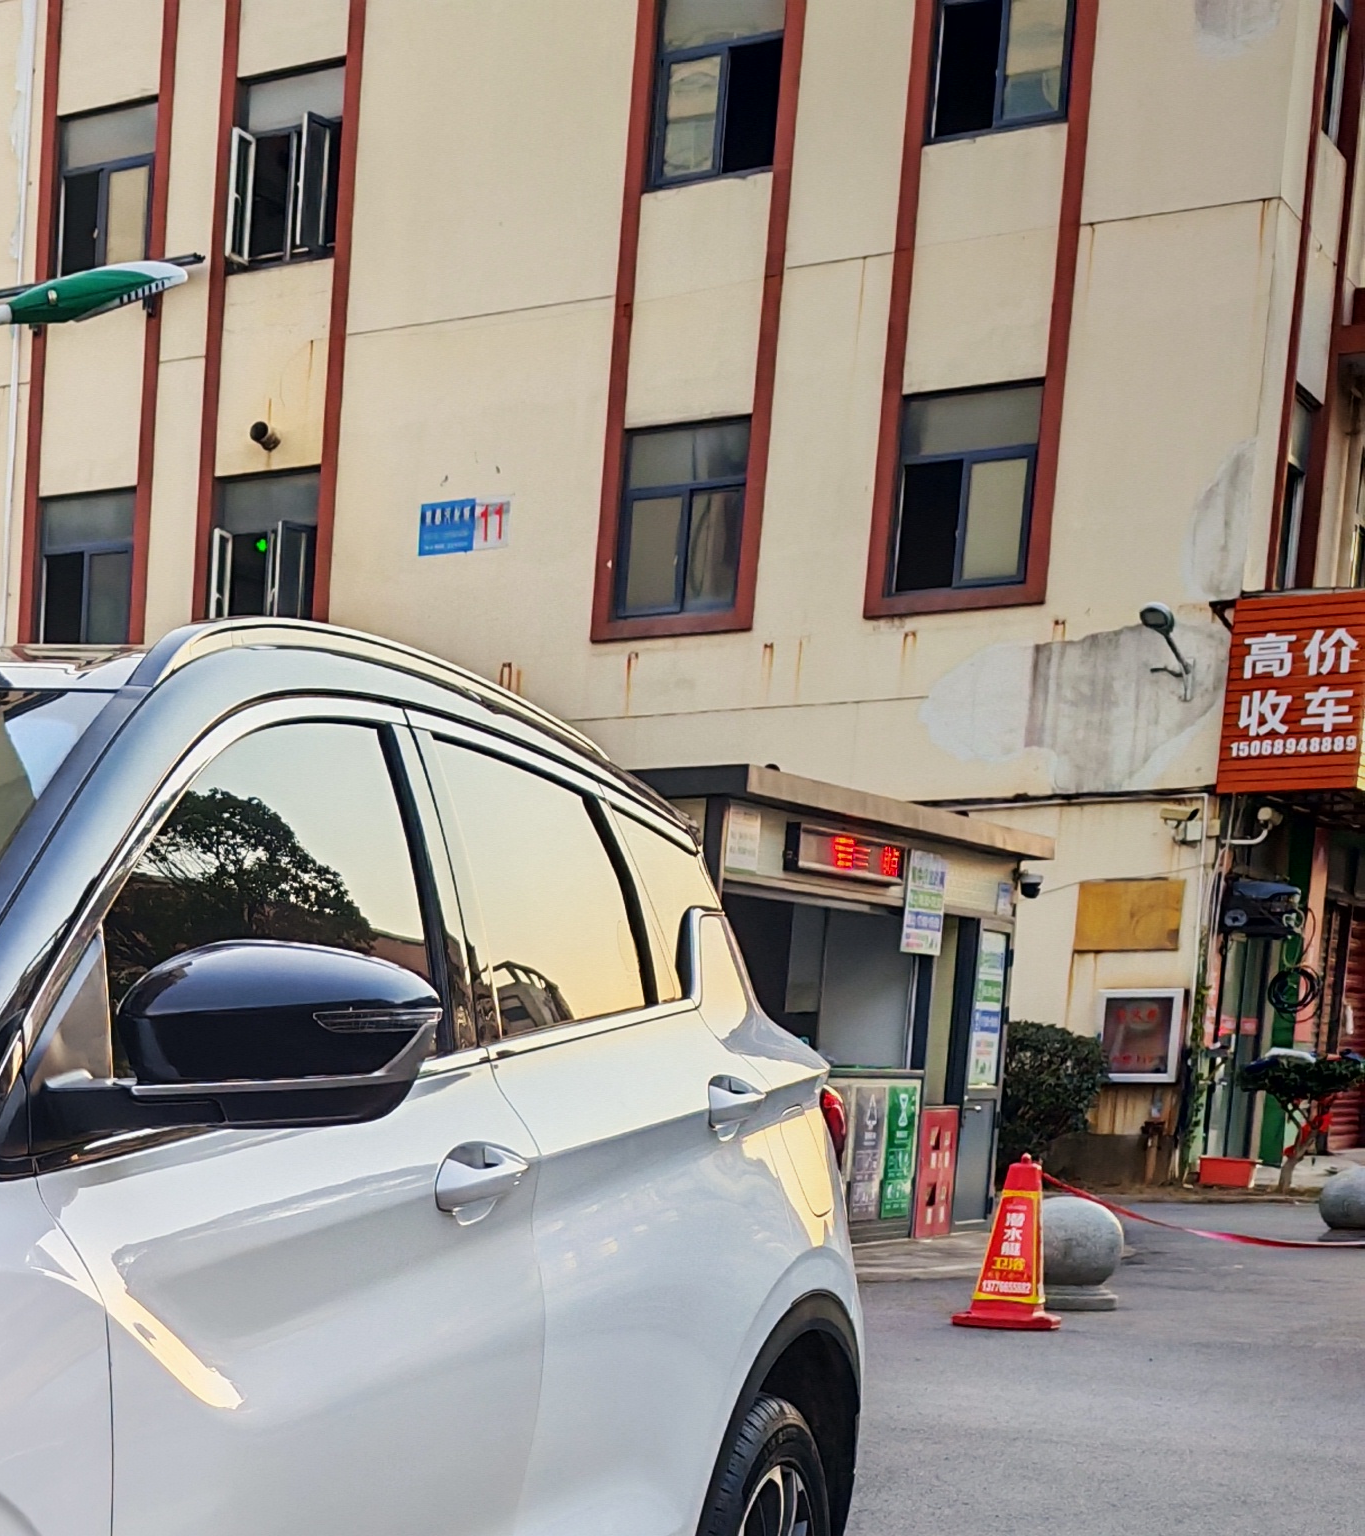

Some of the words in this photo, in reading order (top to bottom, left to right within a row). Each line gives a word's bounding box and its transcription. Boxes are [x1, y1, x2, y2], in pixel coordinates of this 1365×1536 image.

[480, 502, 504, 542] 11
[1243, 628, 1359, 680] 高价
[1238, 686, 1354, 737] 收车
[1230, 735, 1358, 758] 15068948889
